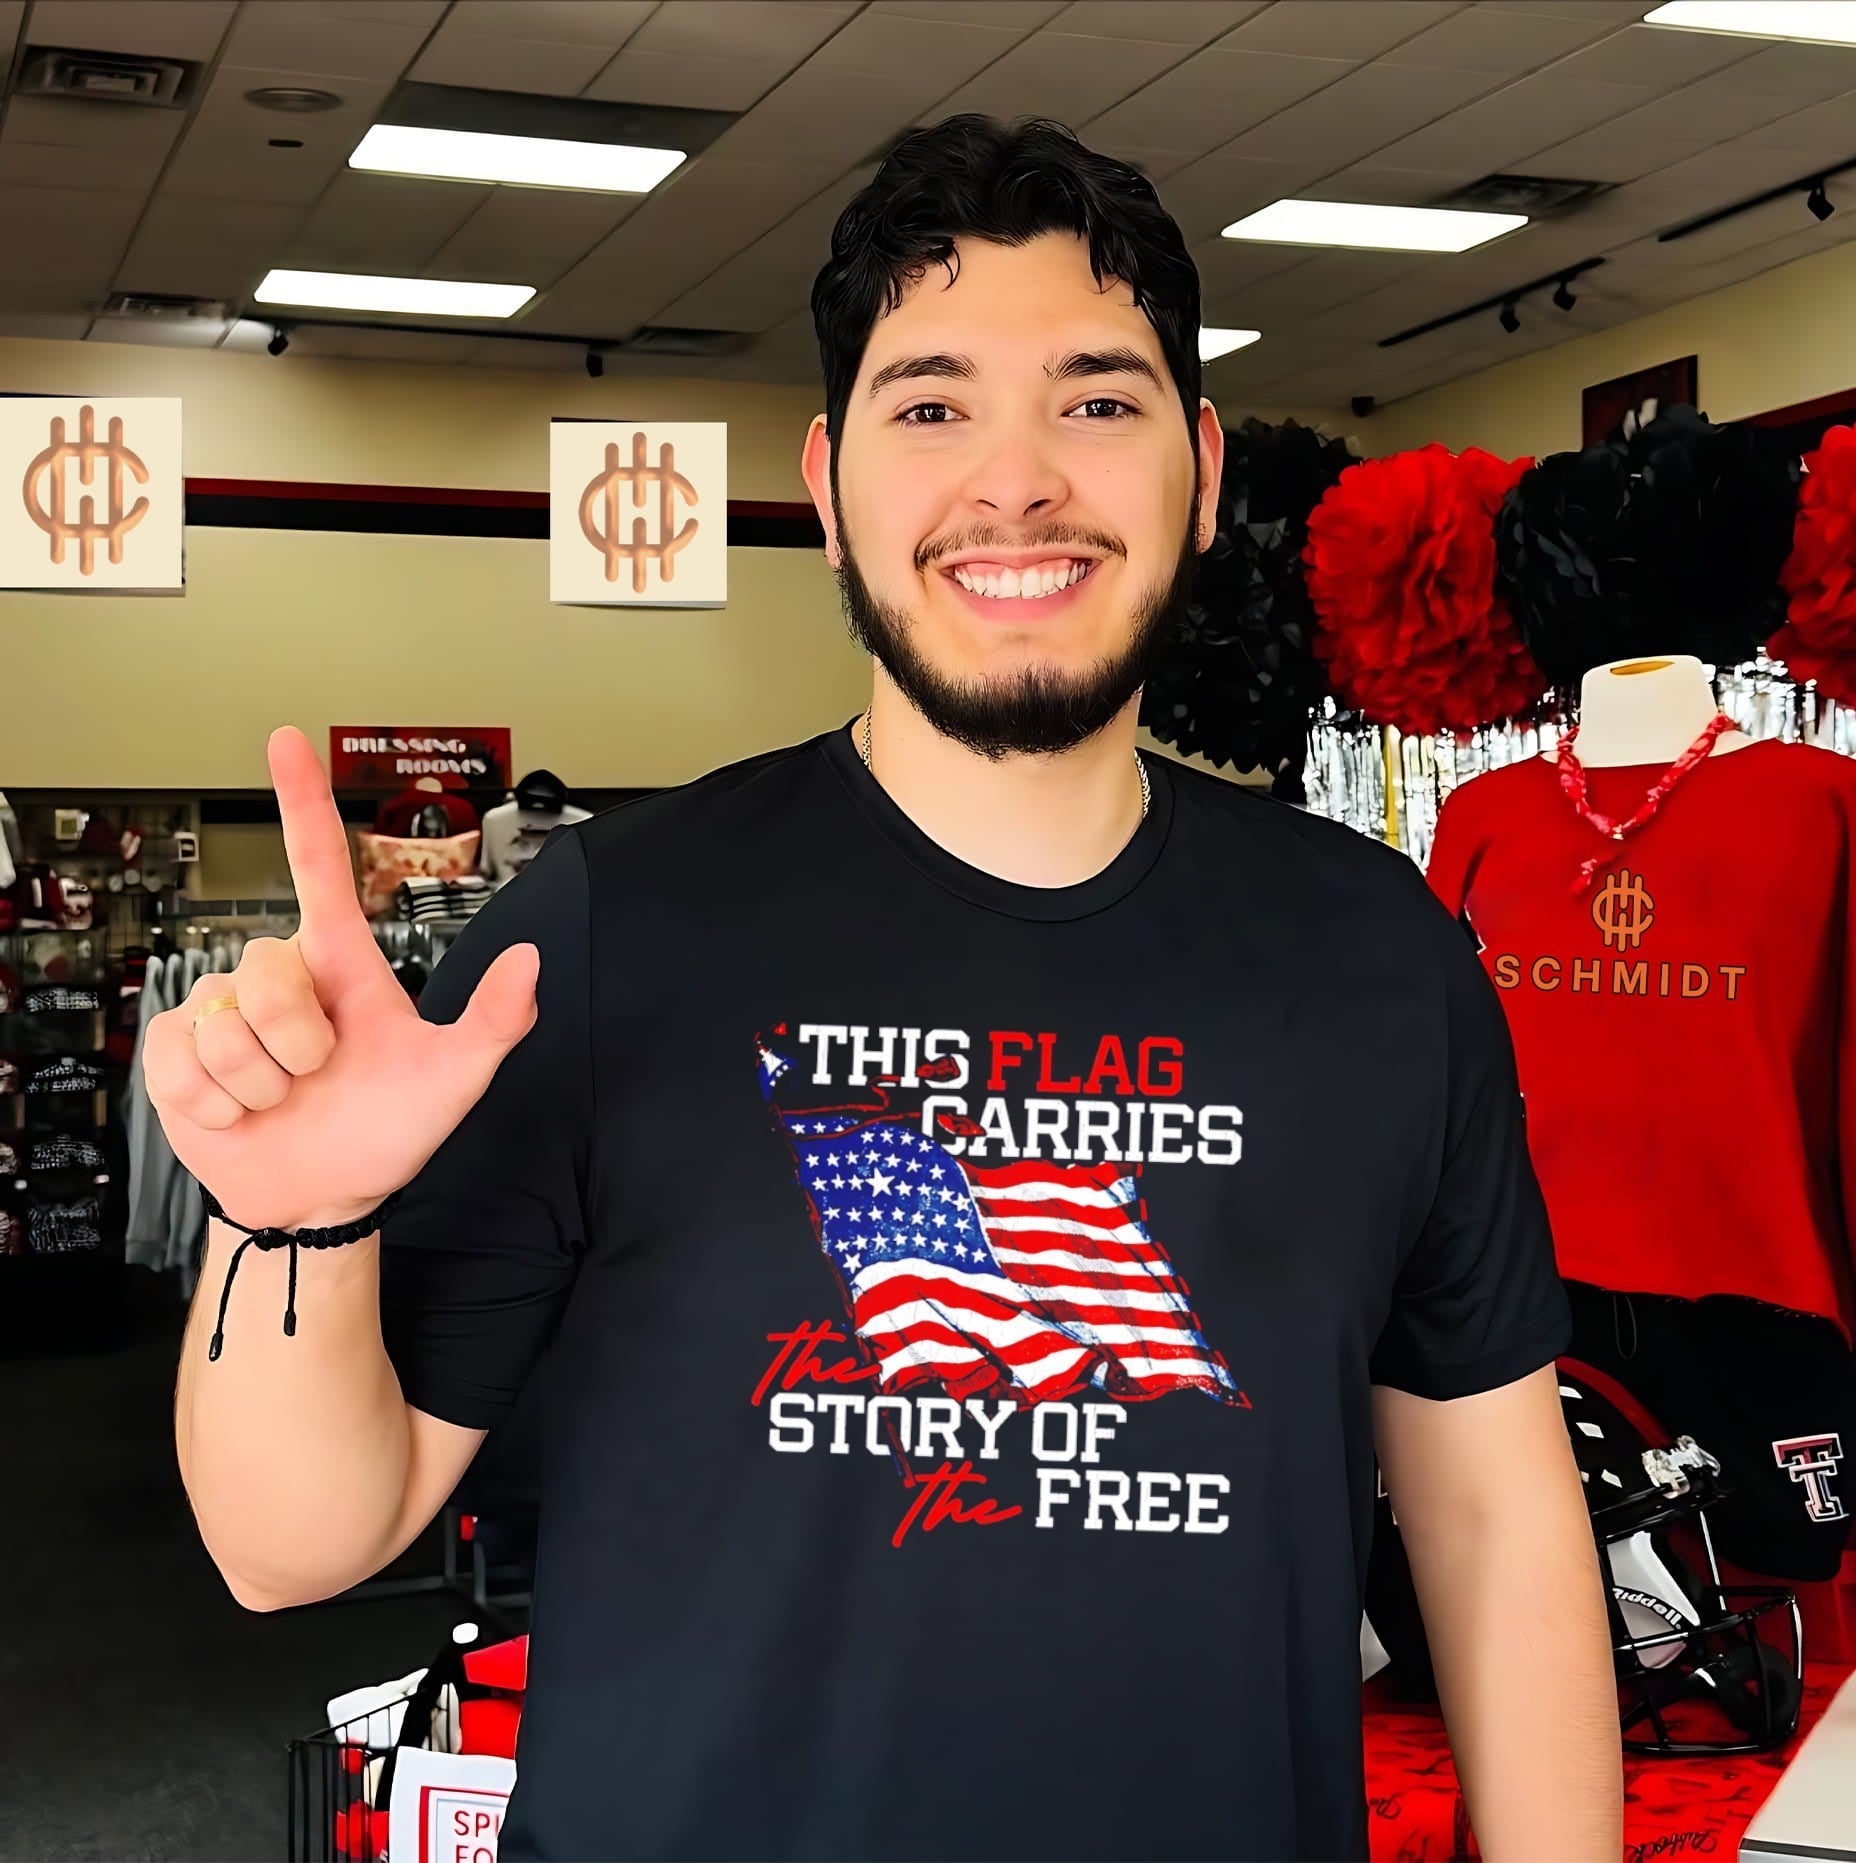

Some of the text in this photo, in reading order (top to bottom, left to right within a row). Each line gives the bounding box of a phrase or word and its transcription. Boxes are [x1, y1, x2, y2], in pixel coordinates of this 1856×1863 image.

[396, 758, 487, 775] ROOMS
[1494, 954, 1747, 1000] SCHMIDT
[799, 1024, 1185, 1097] THIS FLAG
[922, 1095, 1244, 1165] CARRIES
[769, 1392, 1127, 1463] STORY OF
[1035, 1468, 1231, 1534] FREE
